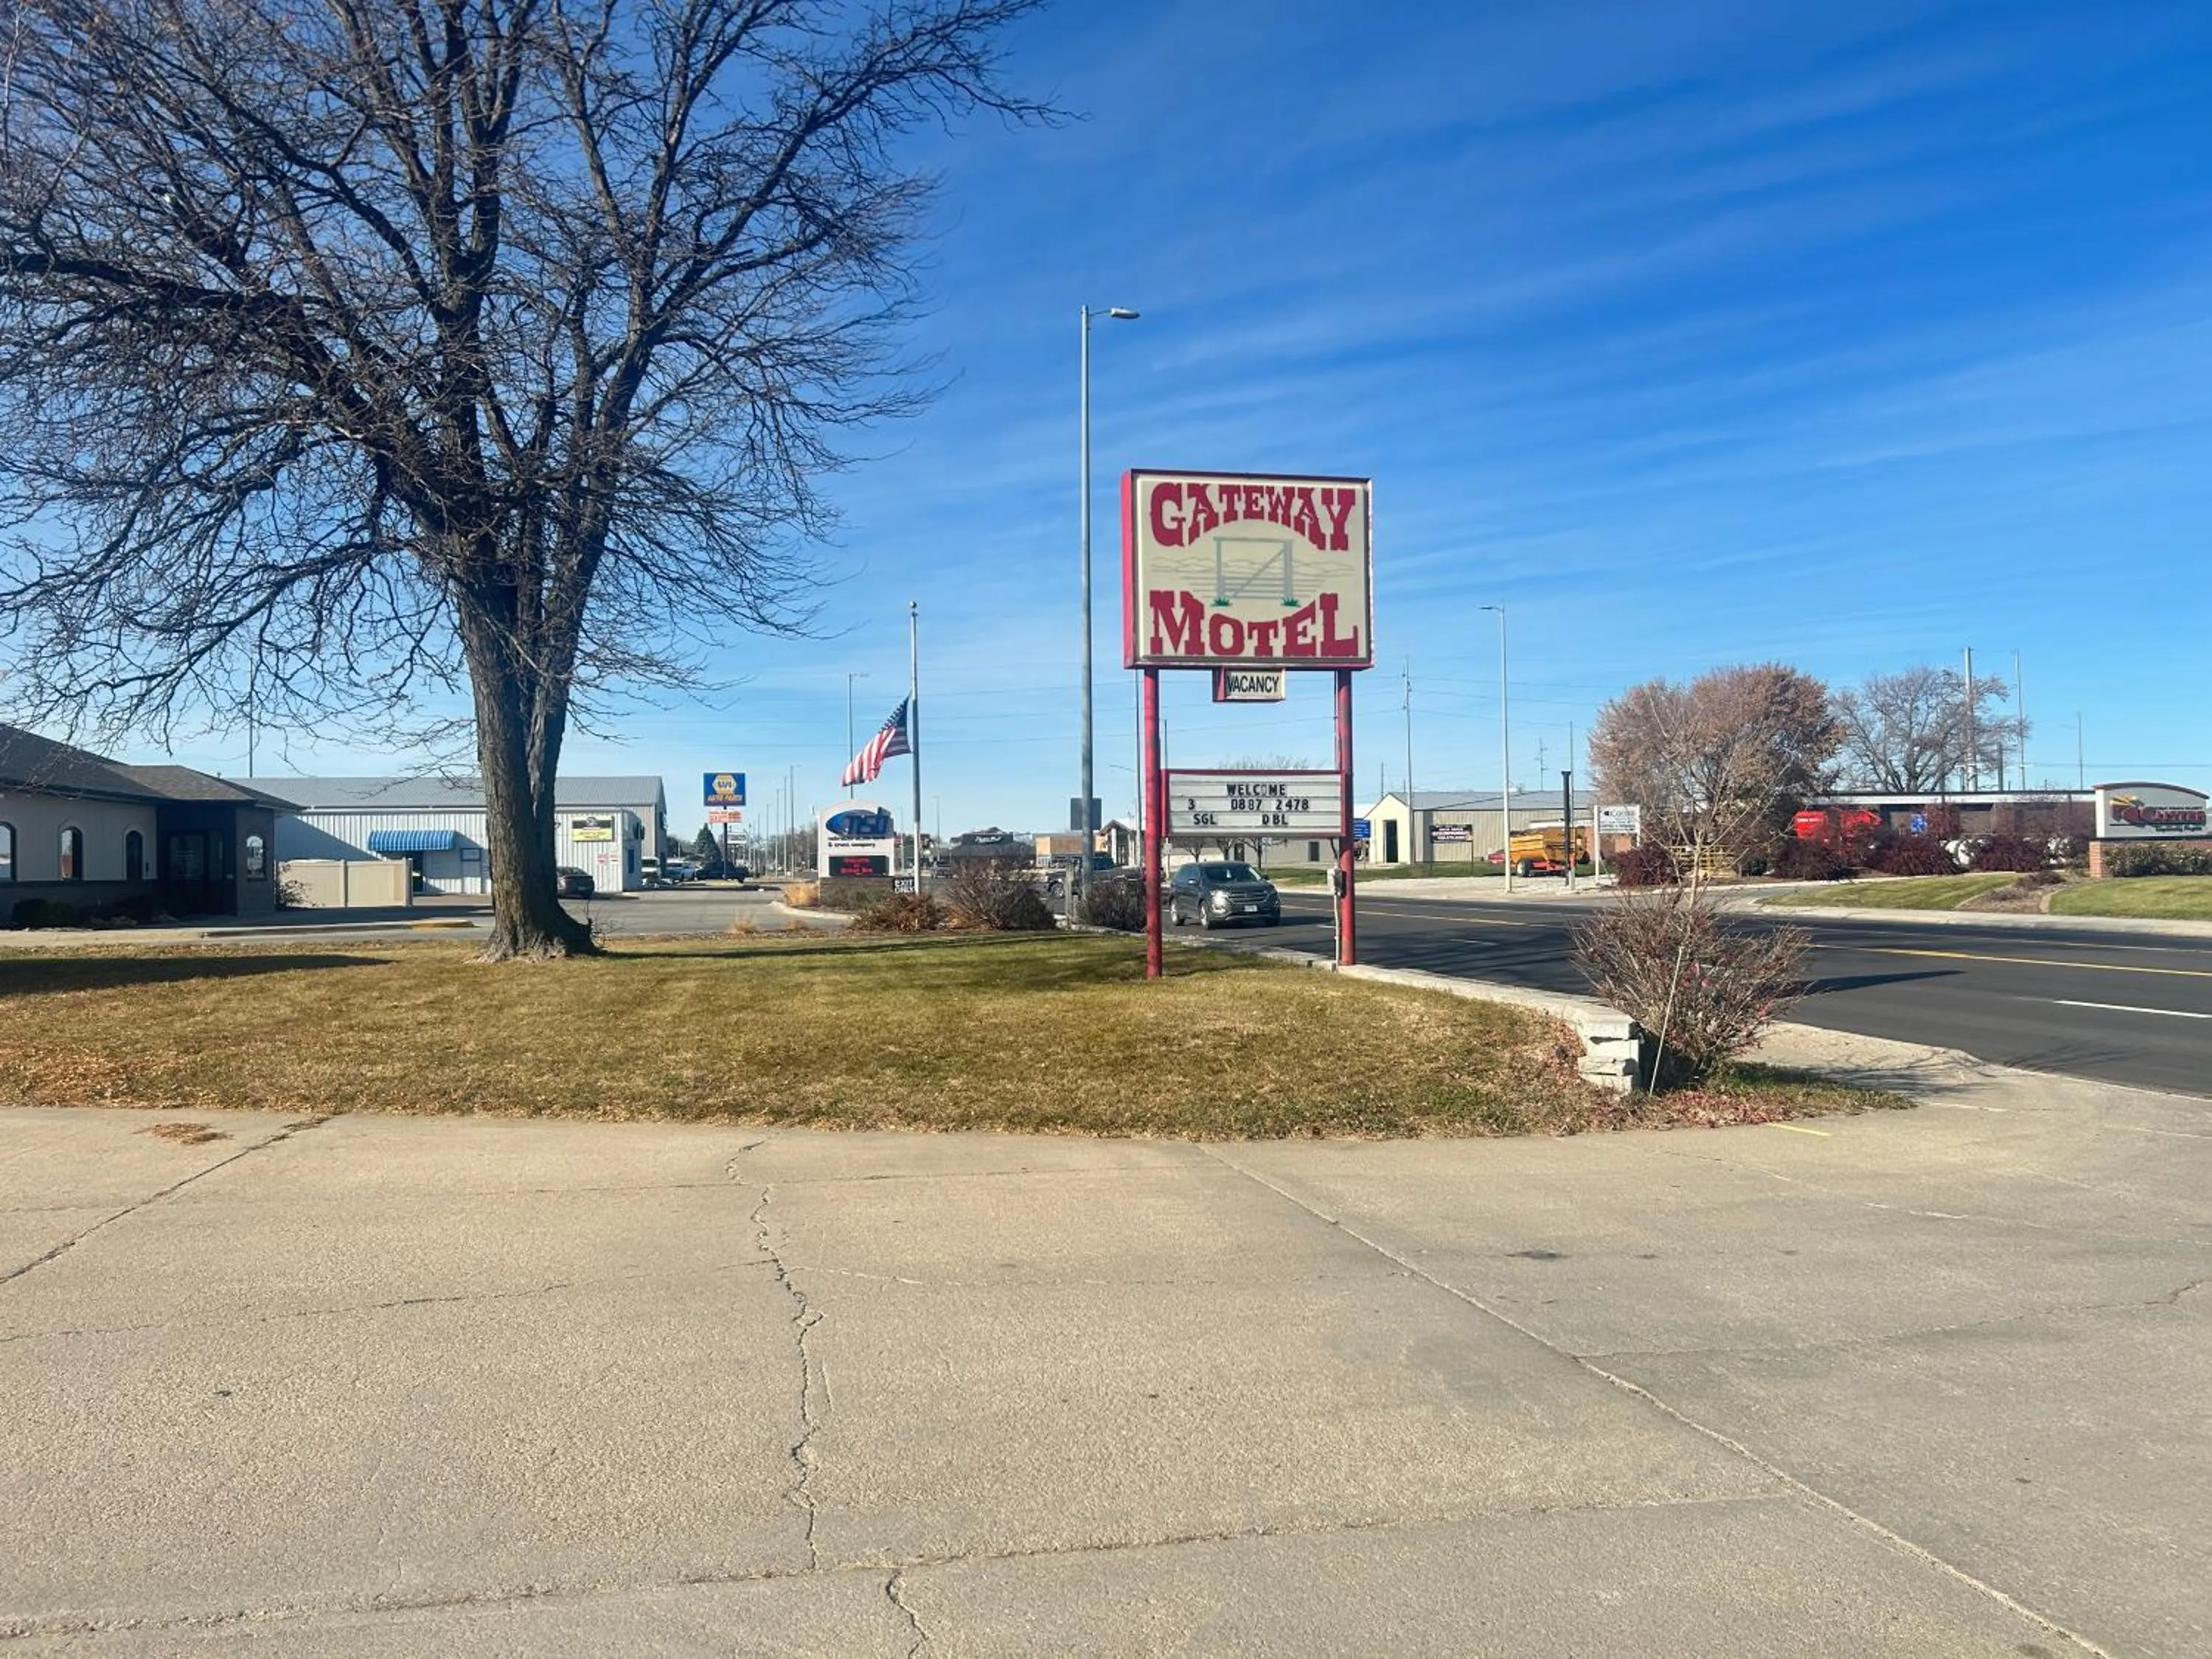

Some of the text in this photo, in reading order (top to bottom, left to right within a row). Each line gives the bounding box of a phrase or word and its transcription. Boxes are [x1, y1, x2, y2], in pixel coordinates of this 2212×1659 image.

[1150, 481, 1356, 551] GATEWAY
[1150, 590, 1359, 657] MOTEL
[1226, 675, 1279, 694] VACANCY
[1226, 784, 1286, 796] WELCOME
[1188, 799, 1195, 810] 3
[1194, 813, 1288, 825] SGL DBL
